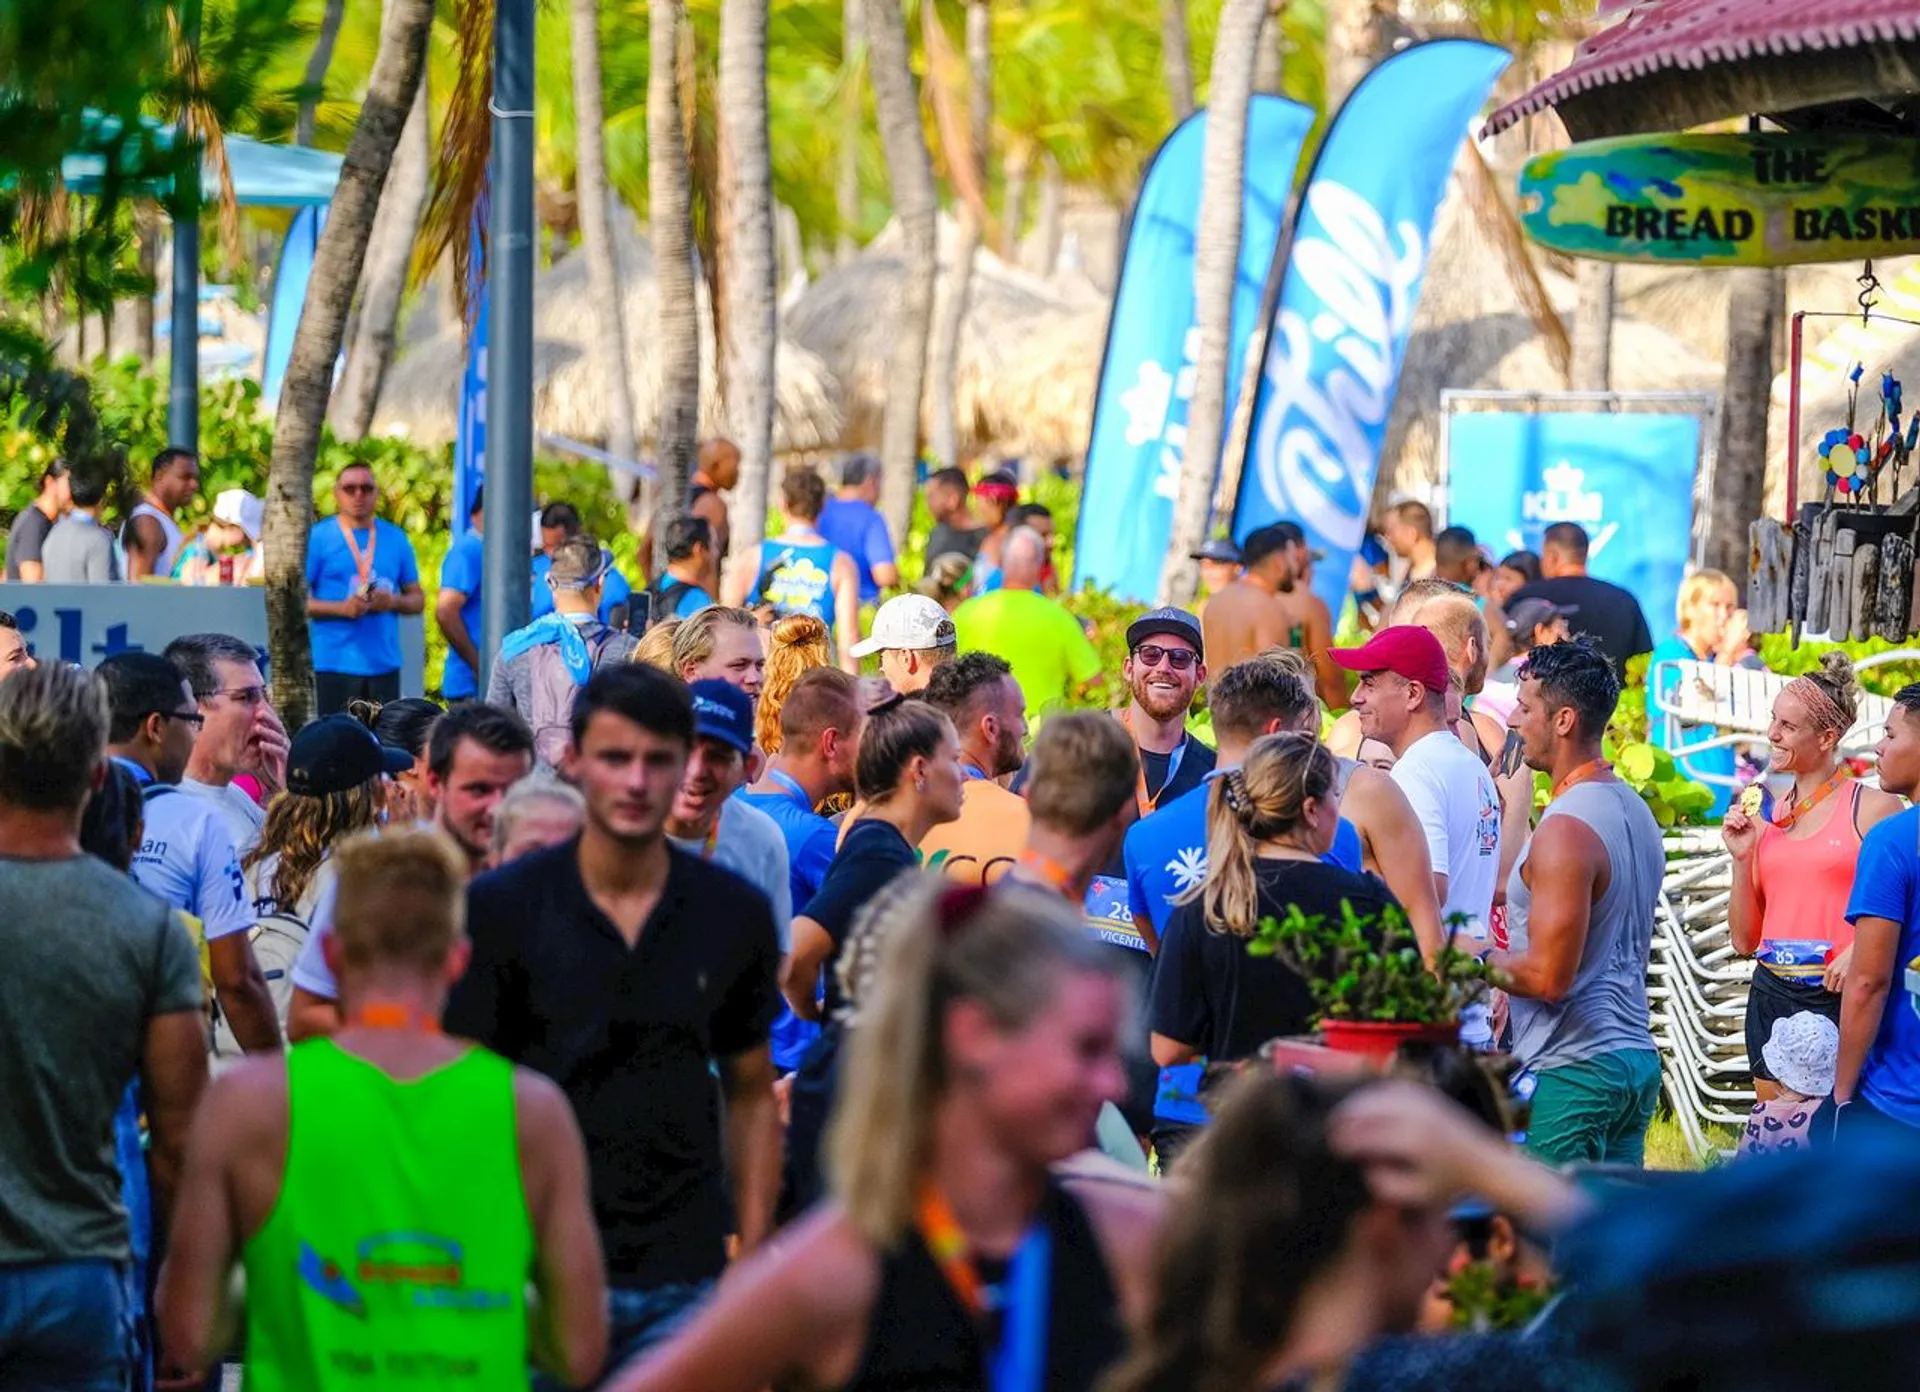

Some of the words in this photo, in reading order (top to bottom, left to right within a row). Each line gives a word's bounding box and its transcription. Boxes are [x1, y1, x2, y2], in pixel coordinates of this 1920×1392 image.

[1750, 148, 1830, 184] THE
[1605, 204, 1755, 242] BREAD
[1100, 929, 1147, 950] VICENTE
